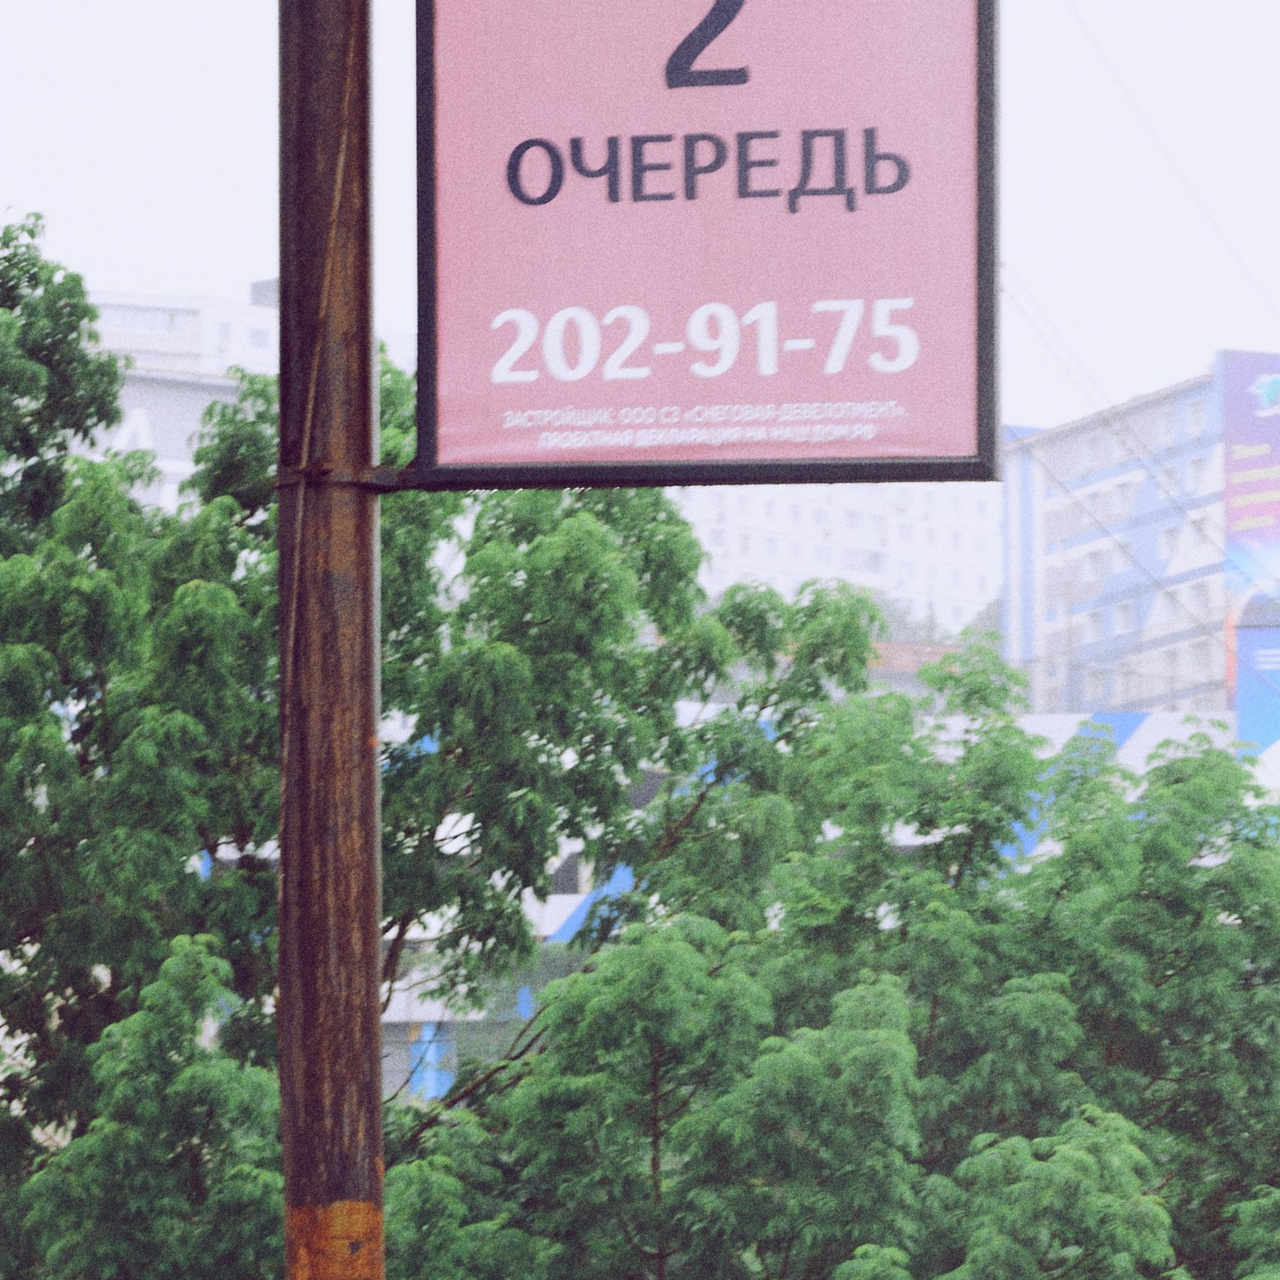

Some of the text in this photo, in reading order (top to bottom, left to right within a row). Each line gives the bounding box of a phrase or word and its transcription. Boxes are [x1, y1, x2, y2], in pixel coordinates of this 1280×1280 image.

[665, 0, 749, 89] 2
[507, 127, 911, 213] ОЧЕРЕДЬ
[491, 298, 920, 384] 202-91-75
